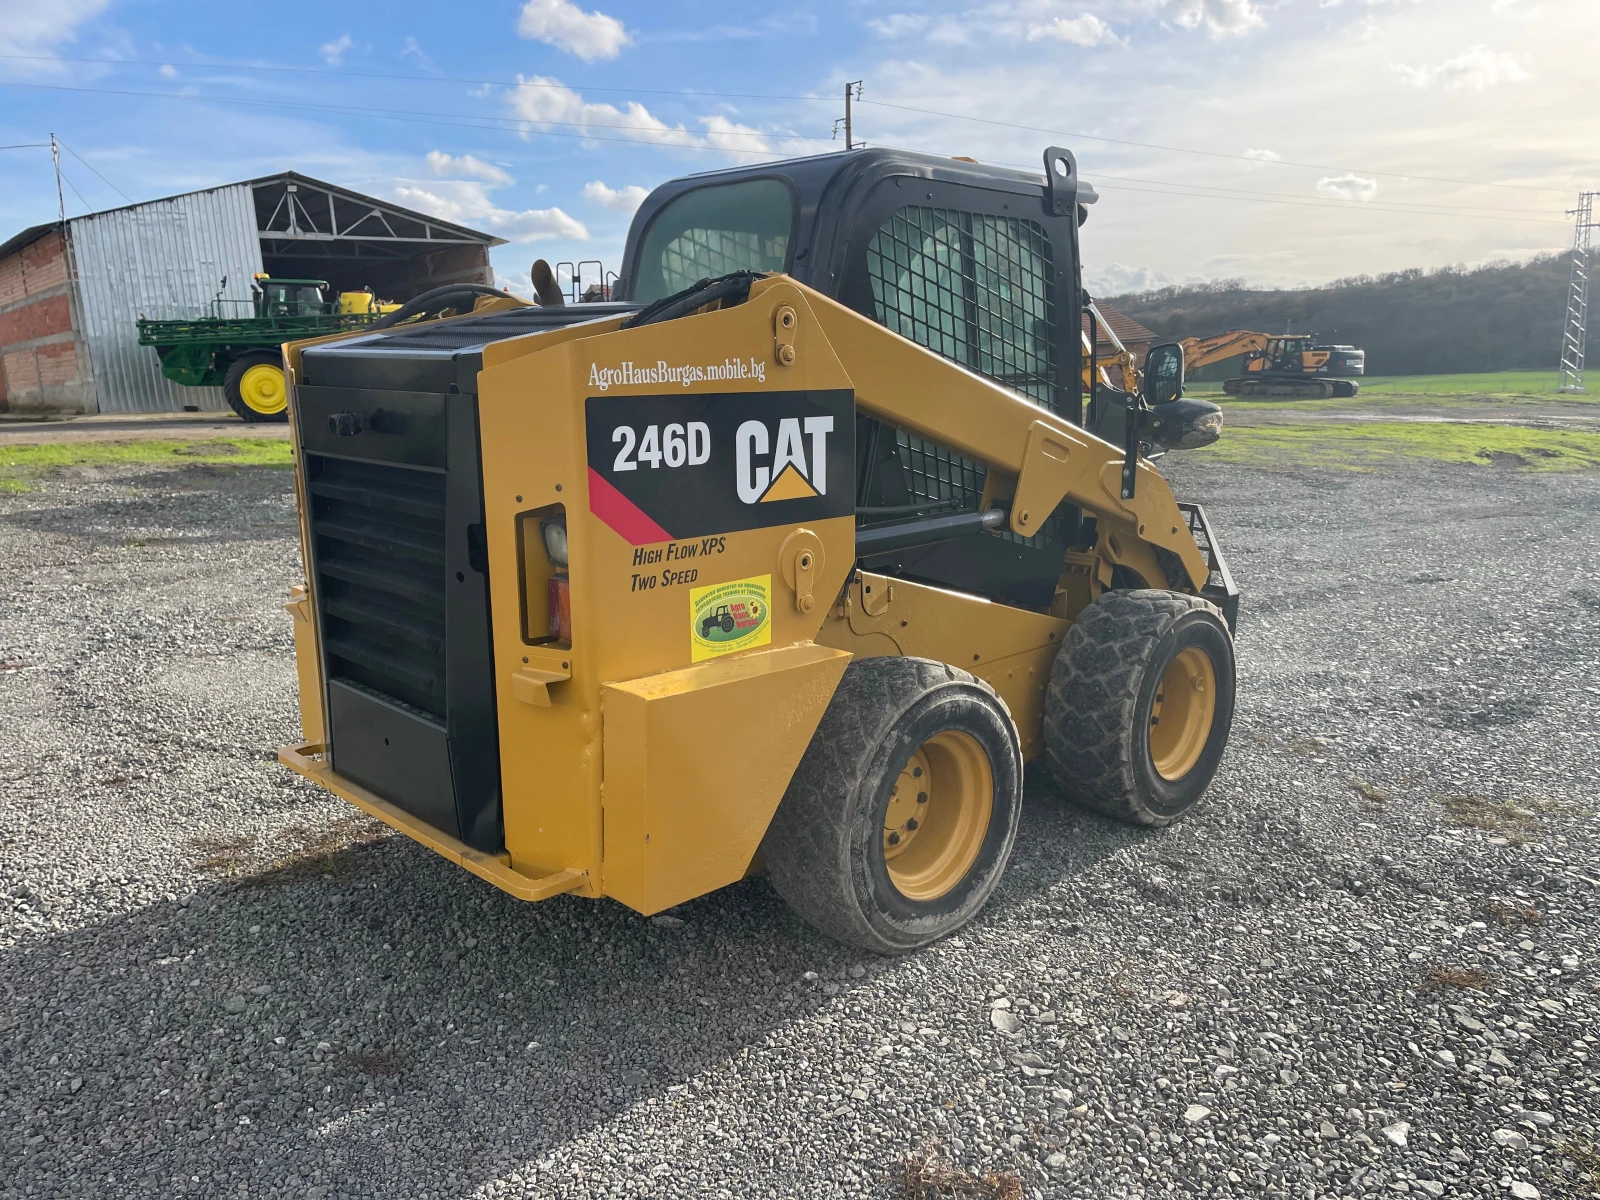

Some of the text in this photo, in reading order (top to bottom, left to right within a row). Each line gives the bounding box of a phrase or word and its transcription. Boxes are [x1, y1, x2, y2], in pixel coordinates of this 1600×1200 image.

[588, 357, 765, 390] AgroHausBurgas.mobile.bg
[611, 421, 711, 472] 246D
[735, 415, 834, 504] CAT
[699, 536, 727, 556] XPS
[730, 602, 746, 612] Agro
[732, 611, 750, 621] Haus
[736, 618, 759, 629] Burgas
